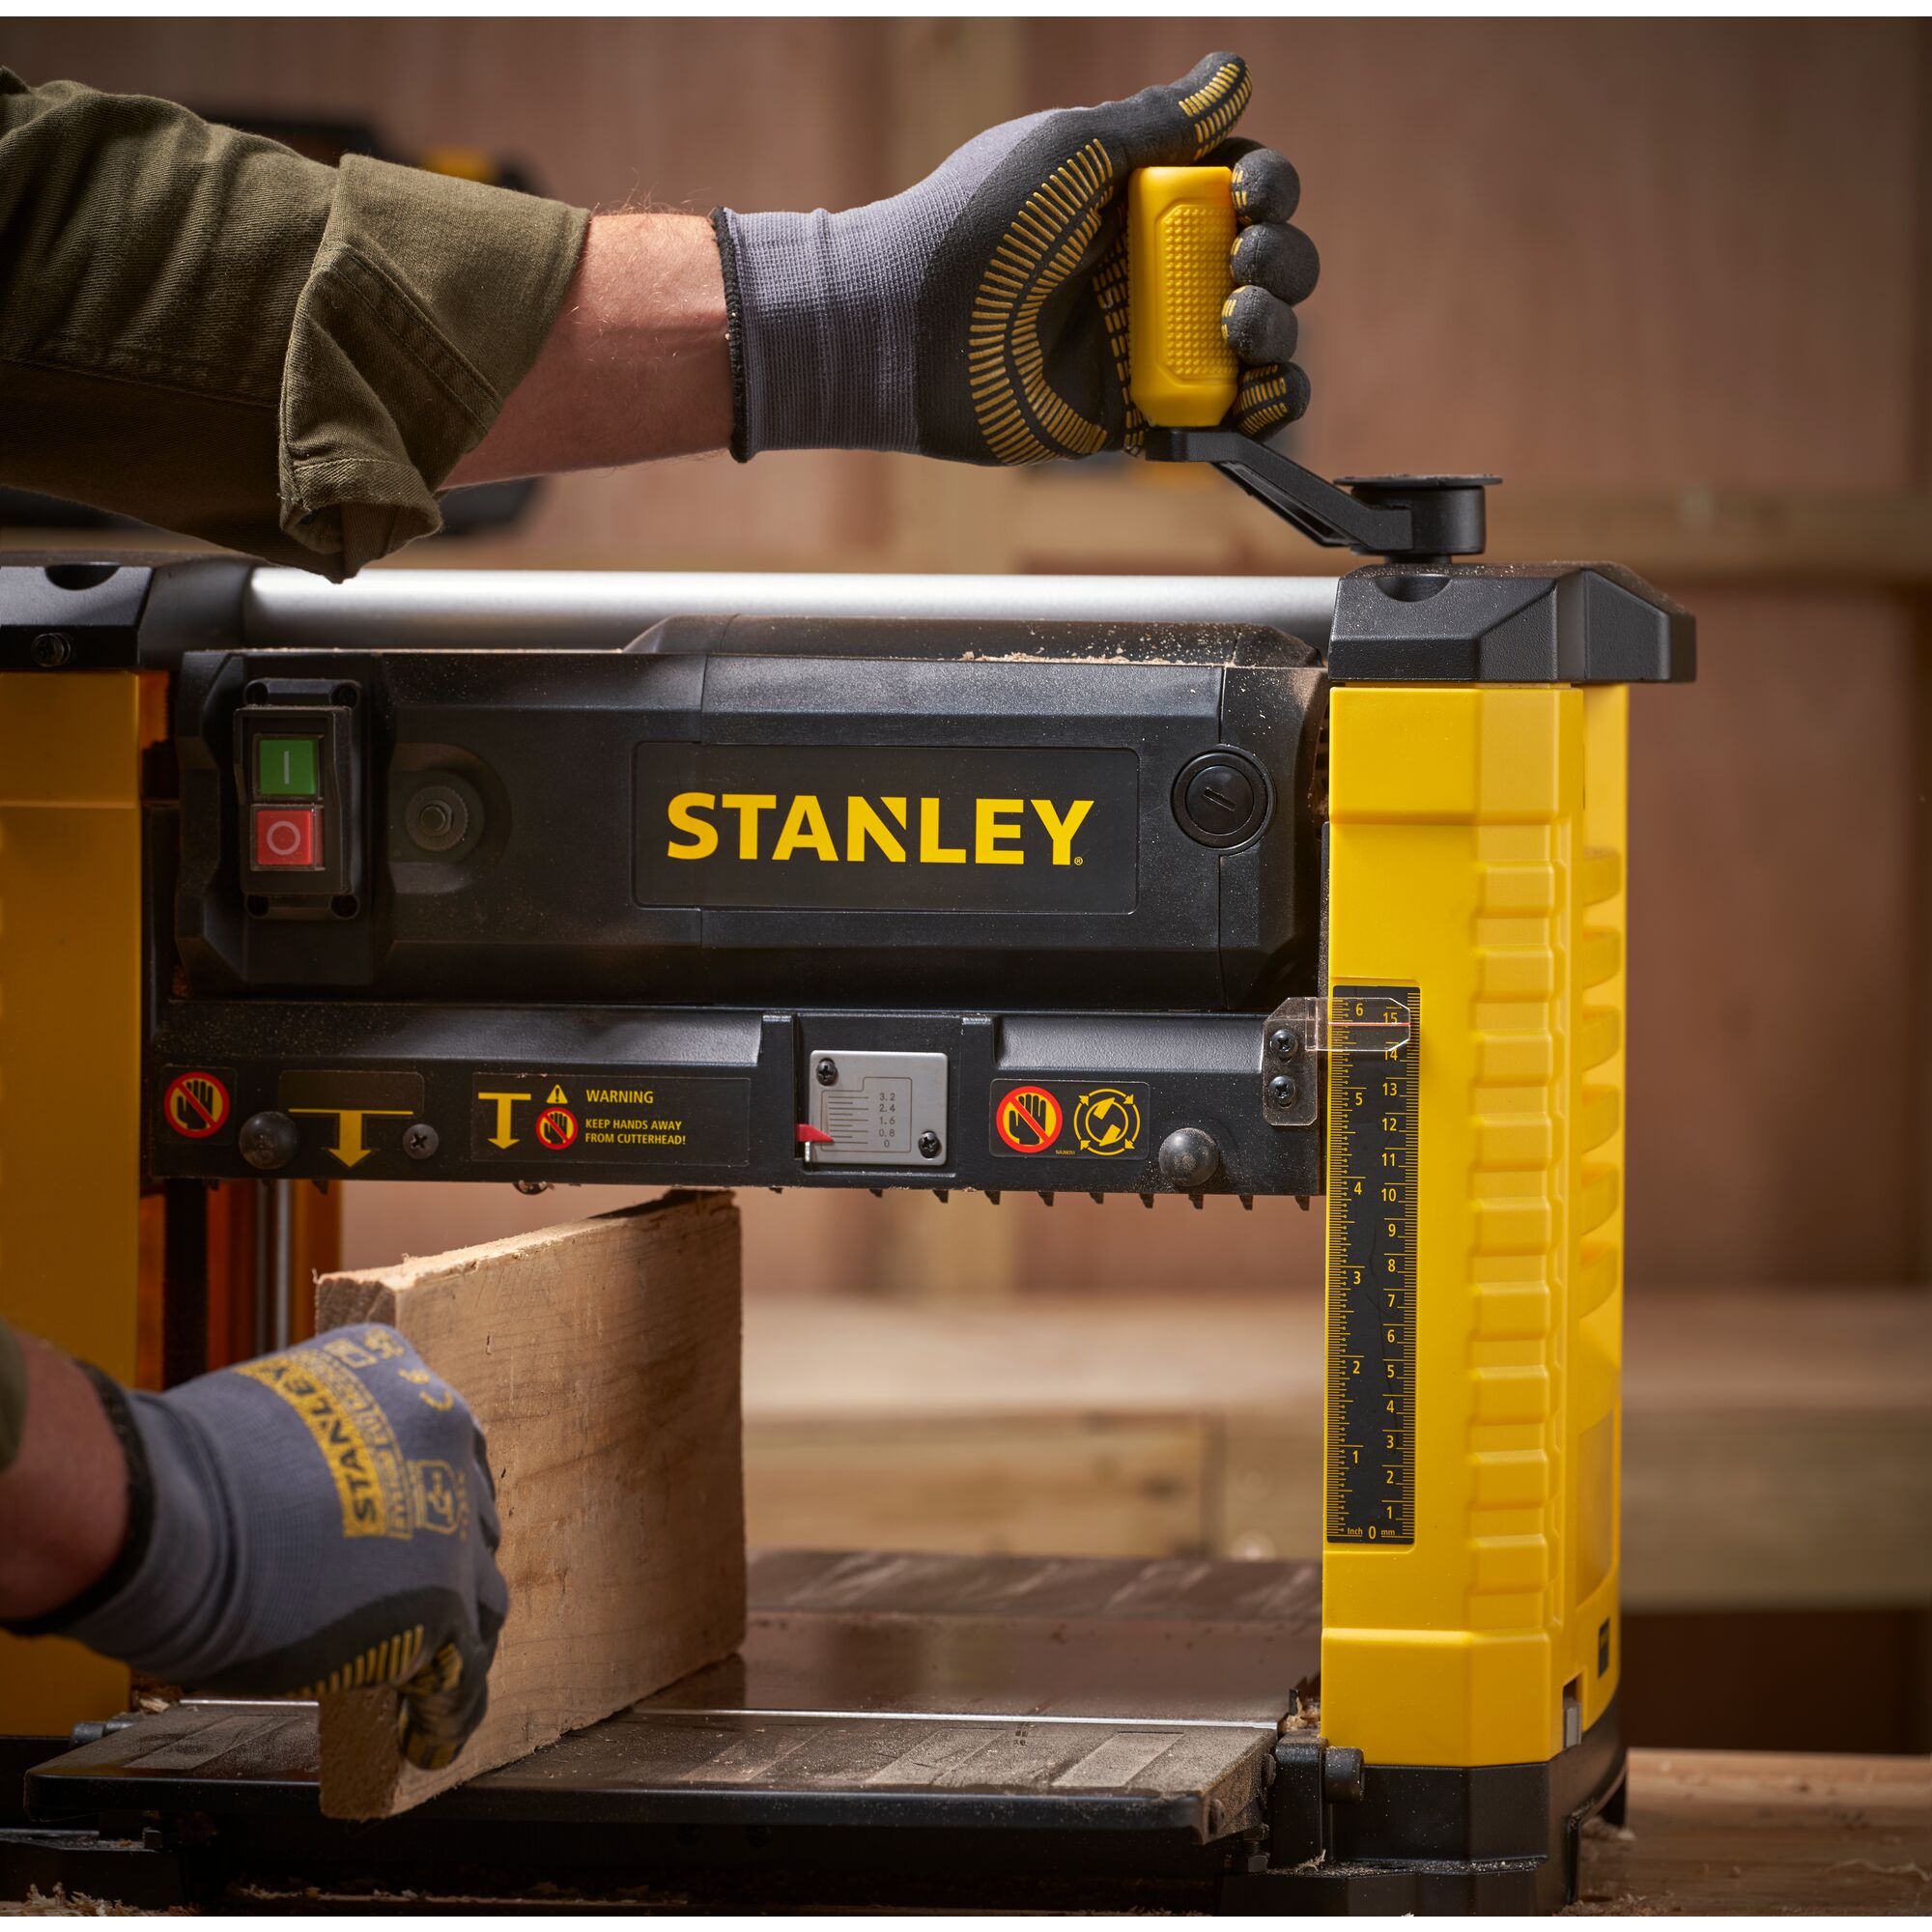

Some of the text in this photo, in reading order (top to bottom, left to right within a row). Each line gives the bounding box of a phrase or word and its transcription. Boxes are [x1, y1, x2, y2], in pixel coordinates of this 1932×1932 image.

[667, 791, 1095, 866] STANLEY
[1355, 1003, 1364, 1017] 6
[1382, 1011, 1398, 1025] 15
[1383, 1046, 1398, 1061] 14
[1382, 1083, 1398, 1096] 13
[585, 1090, 654, 1104] WARNING
[879, 1093, 895, 1101] 3.2
[1355, 1093, 1363, 1106] 5
[879, 1103, 895, 1113] 2.4
[585, 1119, 682, 1131] KEEP HANDS AWAY
[879, 1116, 895, 1125] 1.6
[1381, 1118, 1397, 1131] 12
[584, 1132, 687, 1146] FROM CUTTERHEAD!
[878, 1128, 895, 1138] 0.8
[1381, 1152, 1396, 1167] 11
[1354, 1181, 1362, 1195] 4
[1381, 1188, 1397, 1202] 10
[1388, 1223, 1396, 1236] 9
[1387, 1259, 1396, 1272] 8
[1353, 1271, 1361, 1285] 3
[1387, 1293, 1396, 1307] 7
[1387, 1329, 1395, 1343] 6
[1352, 1360, 1360, 1375] 2
[1386, 1364, 1395, 1378] 5
[1386, 1400, 1395, 1413] 4
[257, 1364, 379, 1524] STANLEY
[1386, 1435, 1394, 1448] 3
[1352, 1450, 1359, 1463] 1
[1386, 1470, 1394, 1484] 2
[1386, 1505, 1392, 1520] 1
[1347, 1527, 1363, 1536] Inch
[1368, 1525, 1377, 1540] 0
